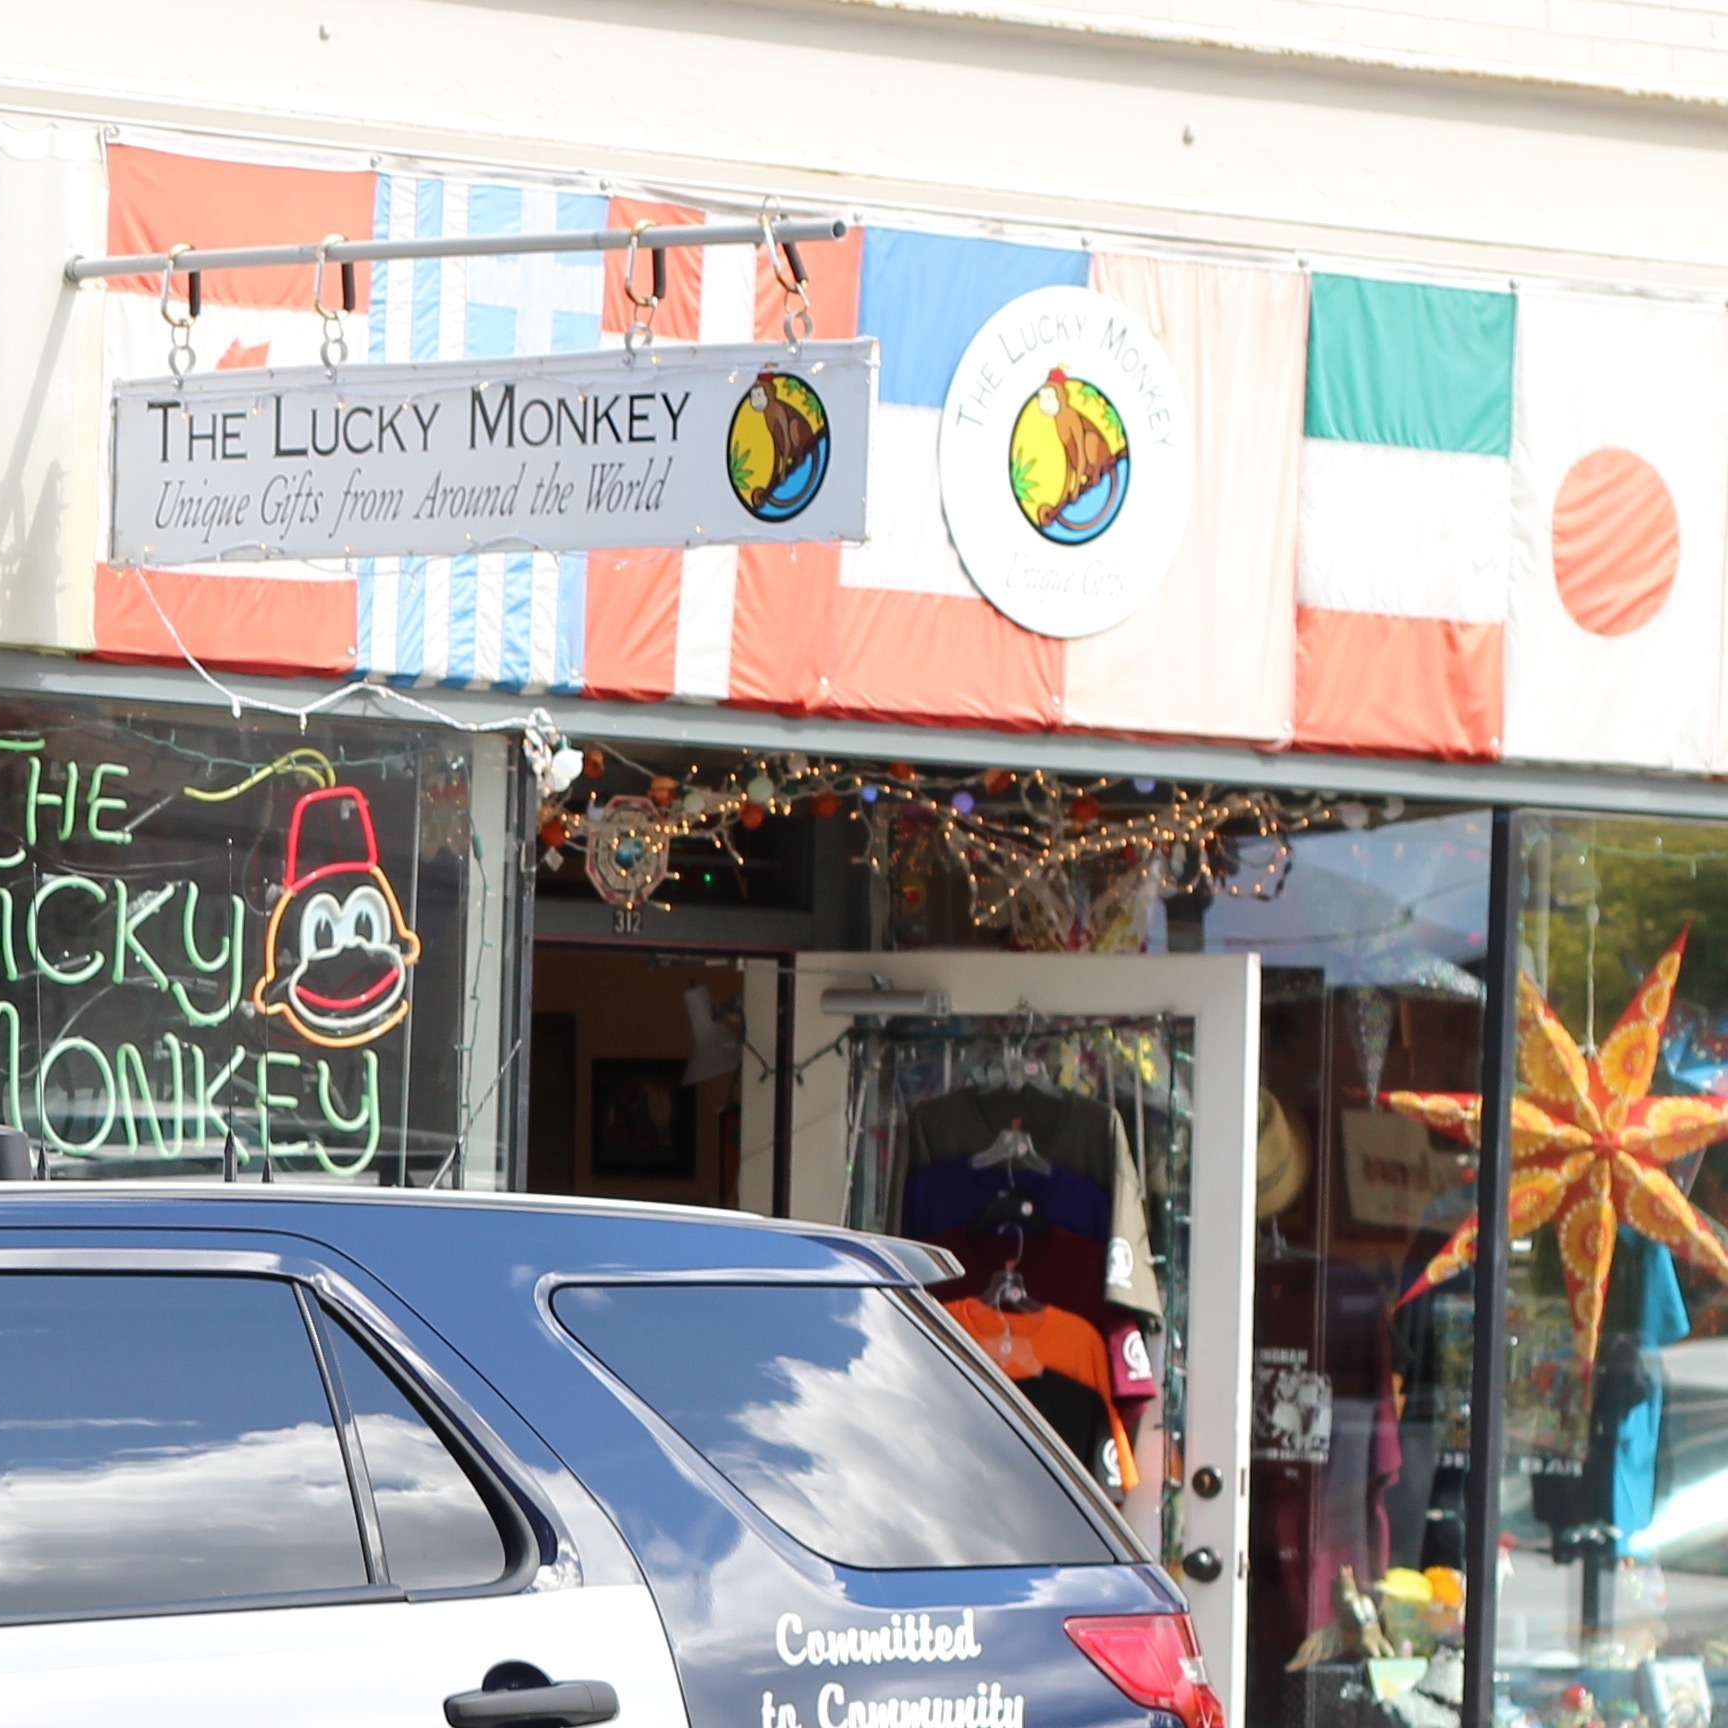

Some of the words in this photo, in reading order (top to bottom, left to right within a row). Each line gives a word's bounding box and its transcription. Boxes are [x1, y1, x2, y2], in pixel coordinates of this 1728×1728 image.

[956, 362, 1003, 427] THE
[998, 313, 1088, 365] LUCKY
[1099, 317, 1175, 448] MONKEY
[147, 400, 249, 463] THE
[273, 395, 441, 458] LUCKY
[468, 384, 693, 451] MONKEY
[155, 478, 250, 543] Unique
[260, 469, 325, 541] Gifts
[328, 468, 405, 540] from
[412, 462, 527, 521] Around
[529, 460, 575, 517] the
[584, 456, 675, 516] World
[615, 910, 641, 935] 312
[775, 1607, 983, 1668] Committed
